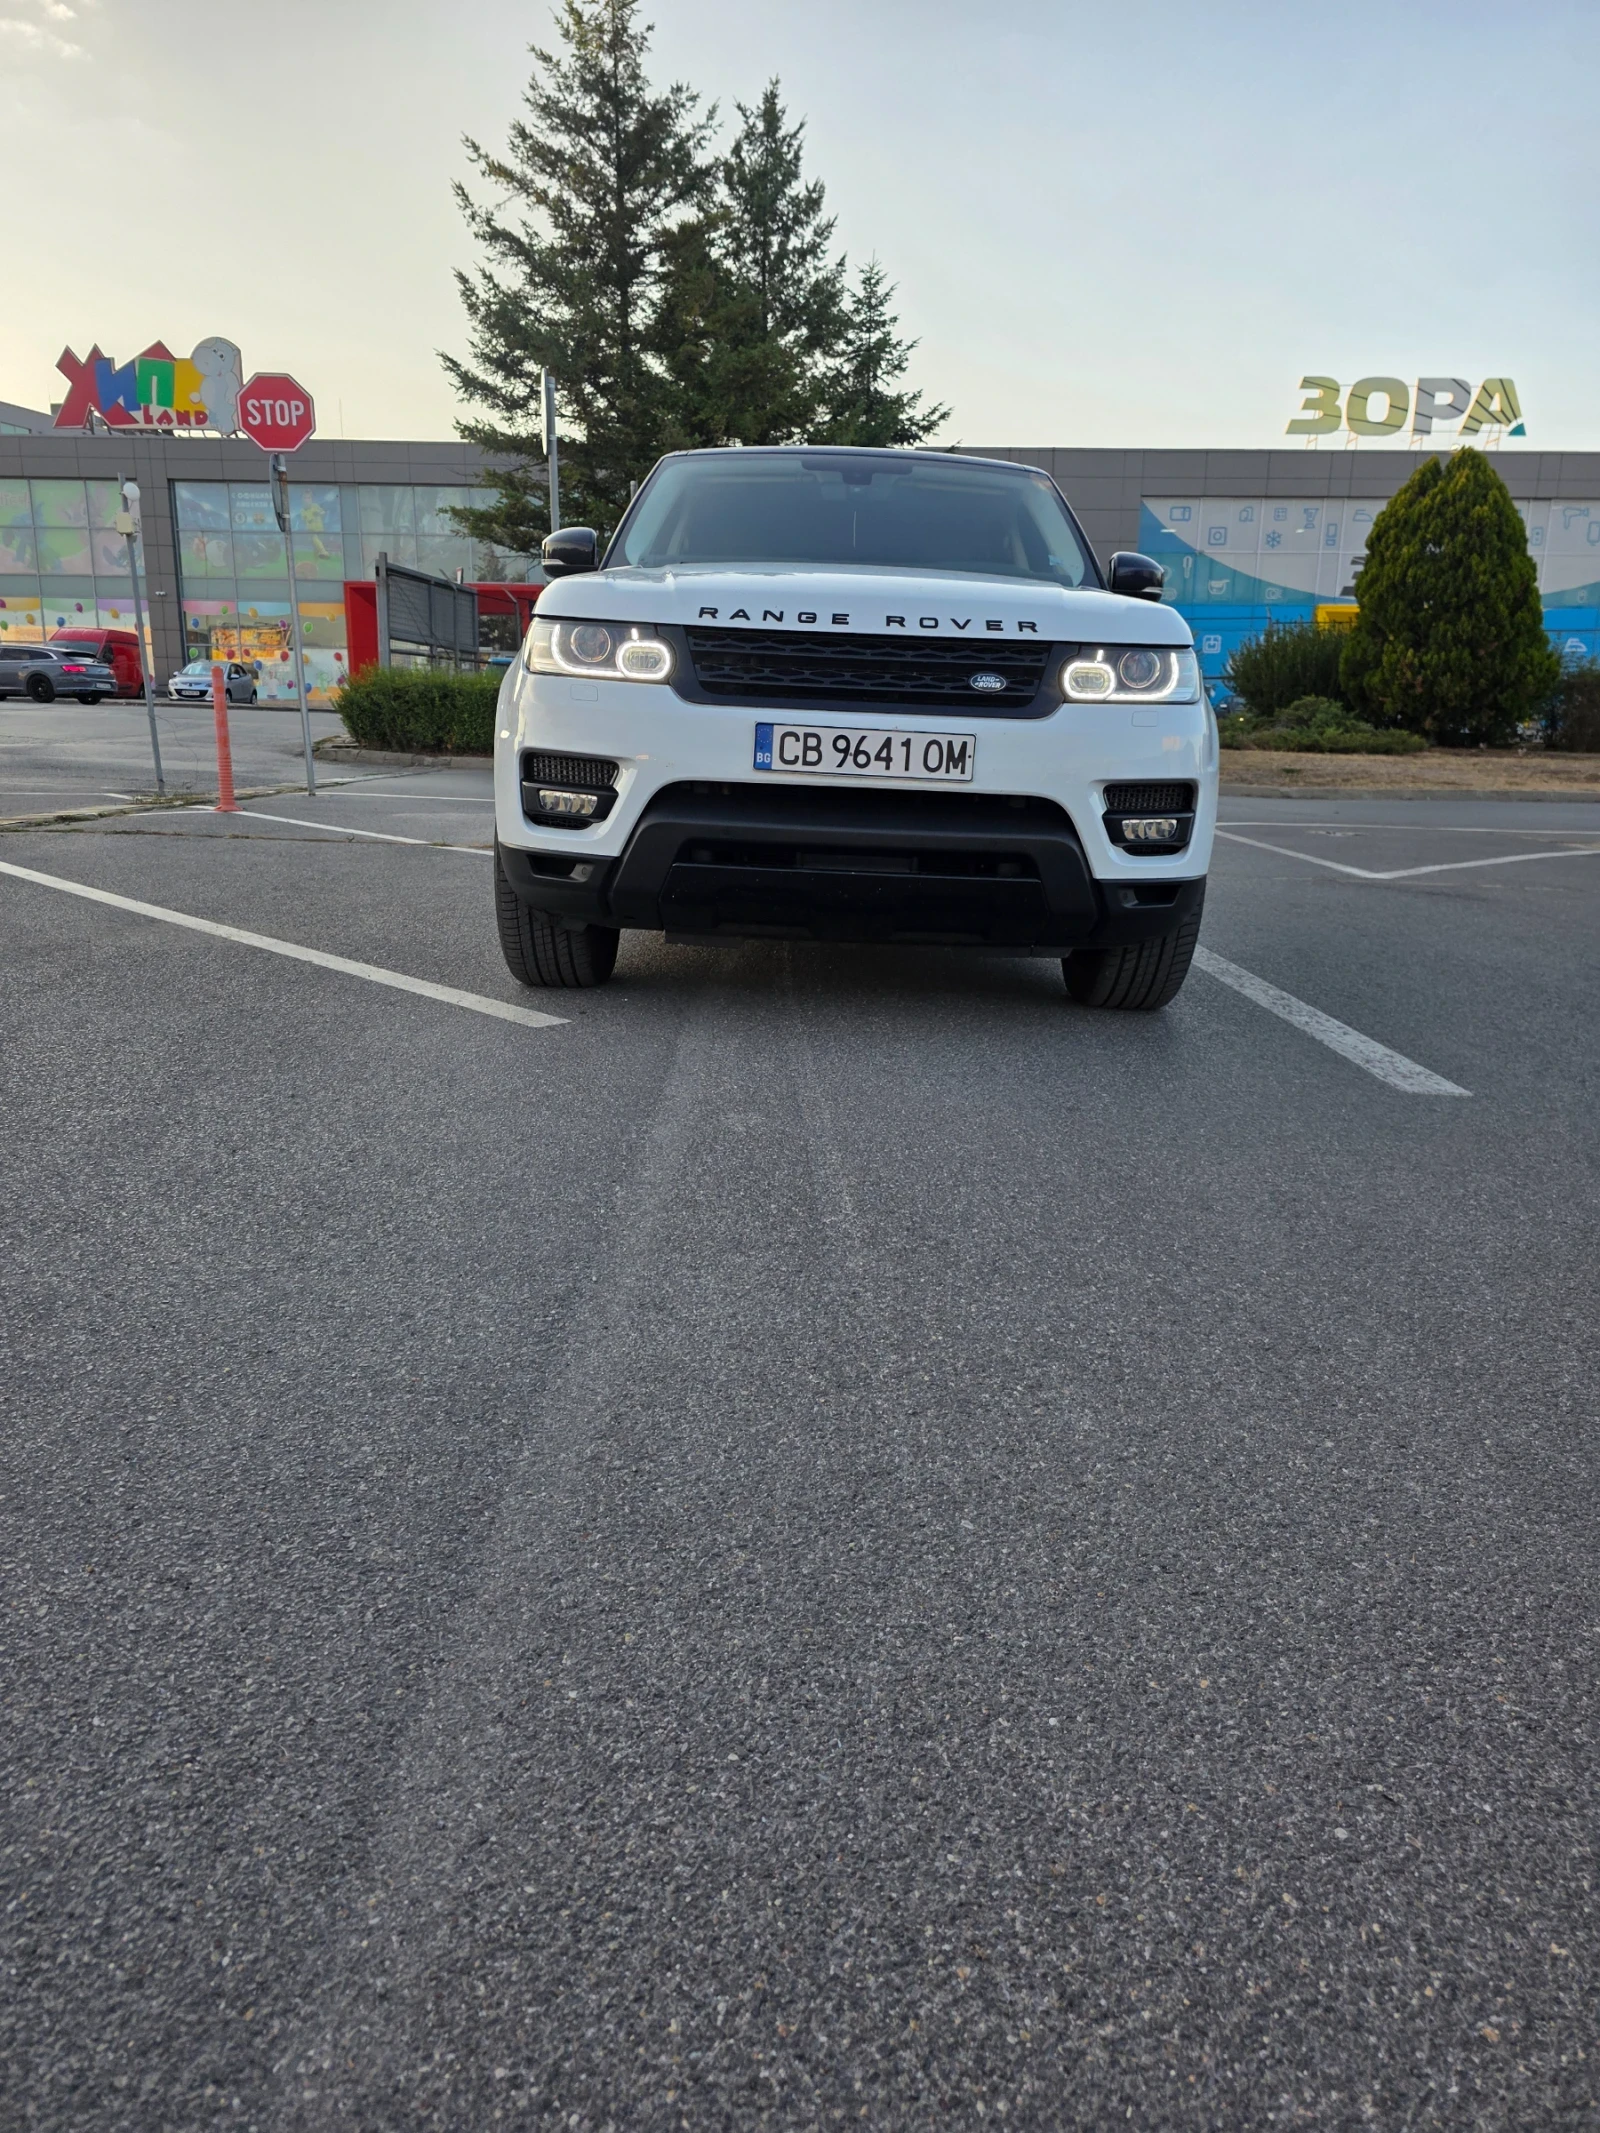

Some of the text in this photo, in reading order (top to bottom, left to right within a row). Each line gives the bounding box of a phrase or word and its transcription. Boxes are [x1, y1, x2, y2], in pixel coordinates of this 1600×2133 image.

[142, 405, 208, 427] LAND
[246, 398, 305, 427] STOP
[1285, 376, 1526, 437] ЗОРА
[698, 606, 1039, 633] RANGE ROVER
[756, 752, 772, 763] BG
[778, 730, 968, 775] CB 9641 OM
